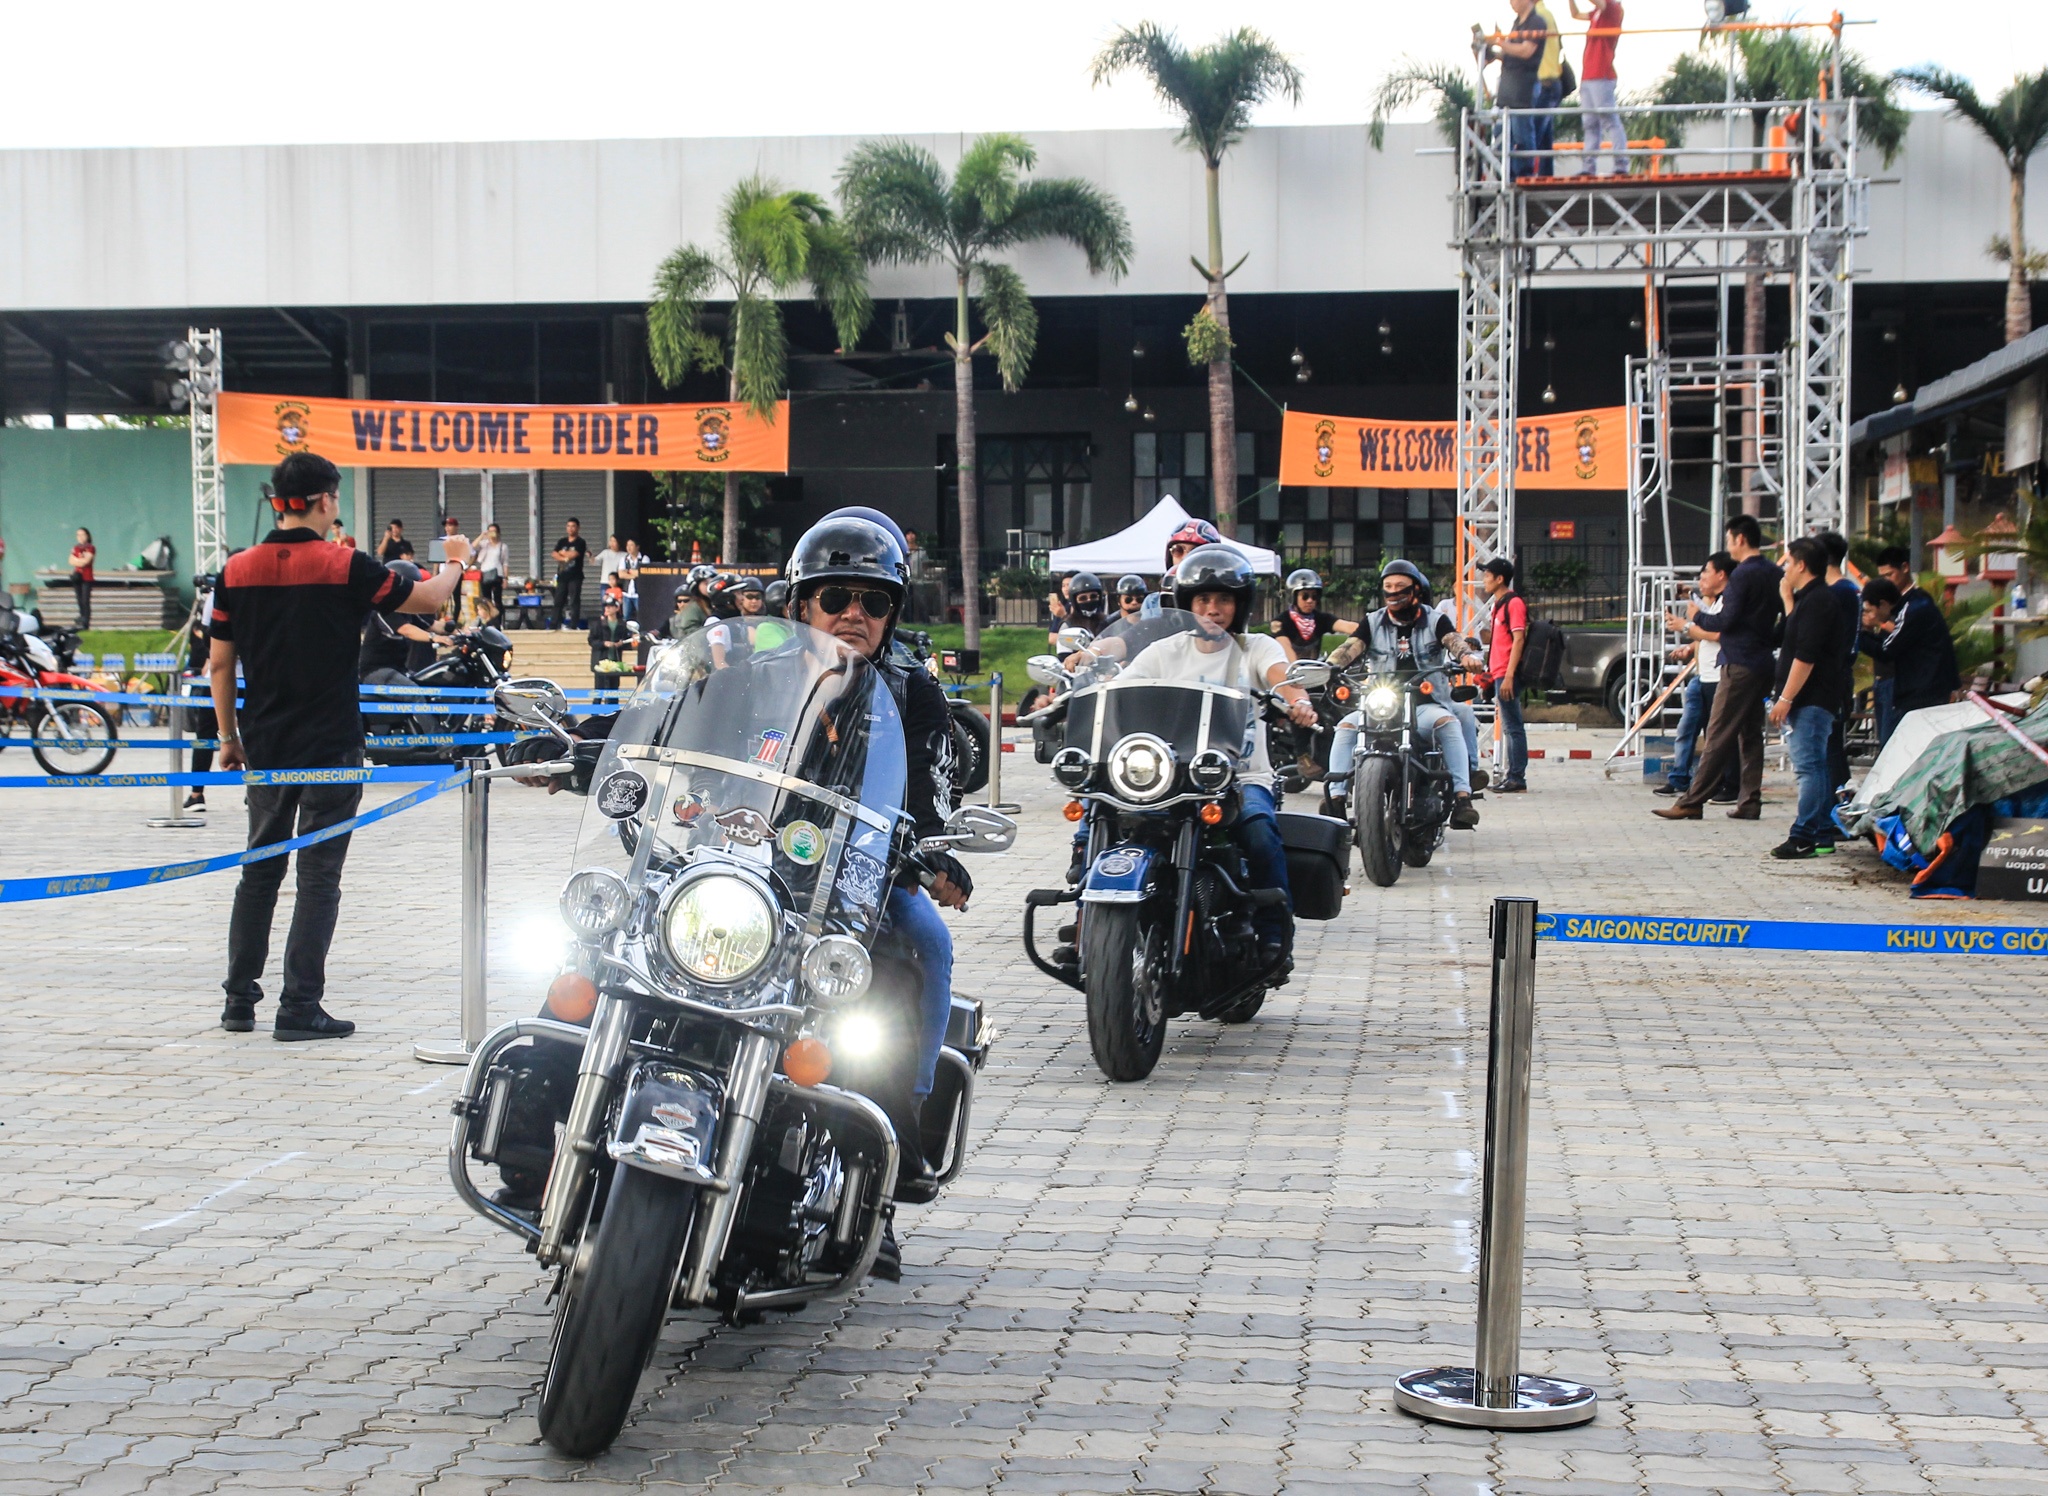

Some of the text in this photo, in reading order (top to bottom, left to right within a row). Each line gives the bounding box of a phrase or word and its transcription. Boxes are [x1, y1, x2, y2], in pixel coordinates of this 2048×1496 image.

[351, 409, 659, 456] WELCOME RIDER
[1358, 428, 1464, 472] WELCOM
[382, 738, 404, 747] VỰC
[407, 735, 429, 744] GIỚI
[431, 736, 454, 746] HẠN
[45, 774, 168, 787] KHU VỰC GIỚI HẠN
[271, 769, 373, 783] SAIGONSECURITY
[729, 823, 760, 842] HOG
[2005, 861, 2046, 871] cotton
[1565, 918, 1750, 943] SAIGONSECURITY
[1886, 929, 2048, 953] KHU VỰC GIỚ
